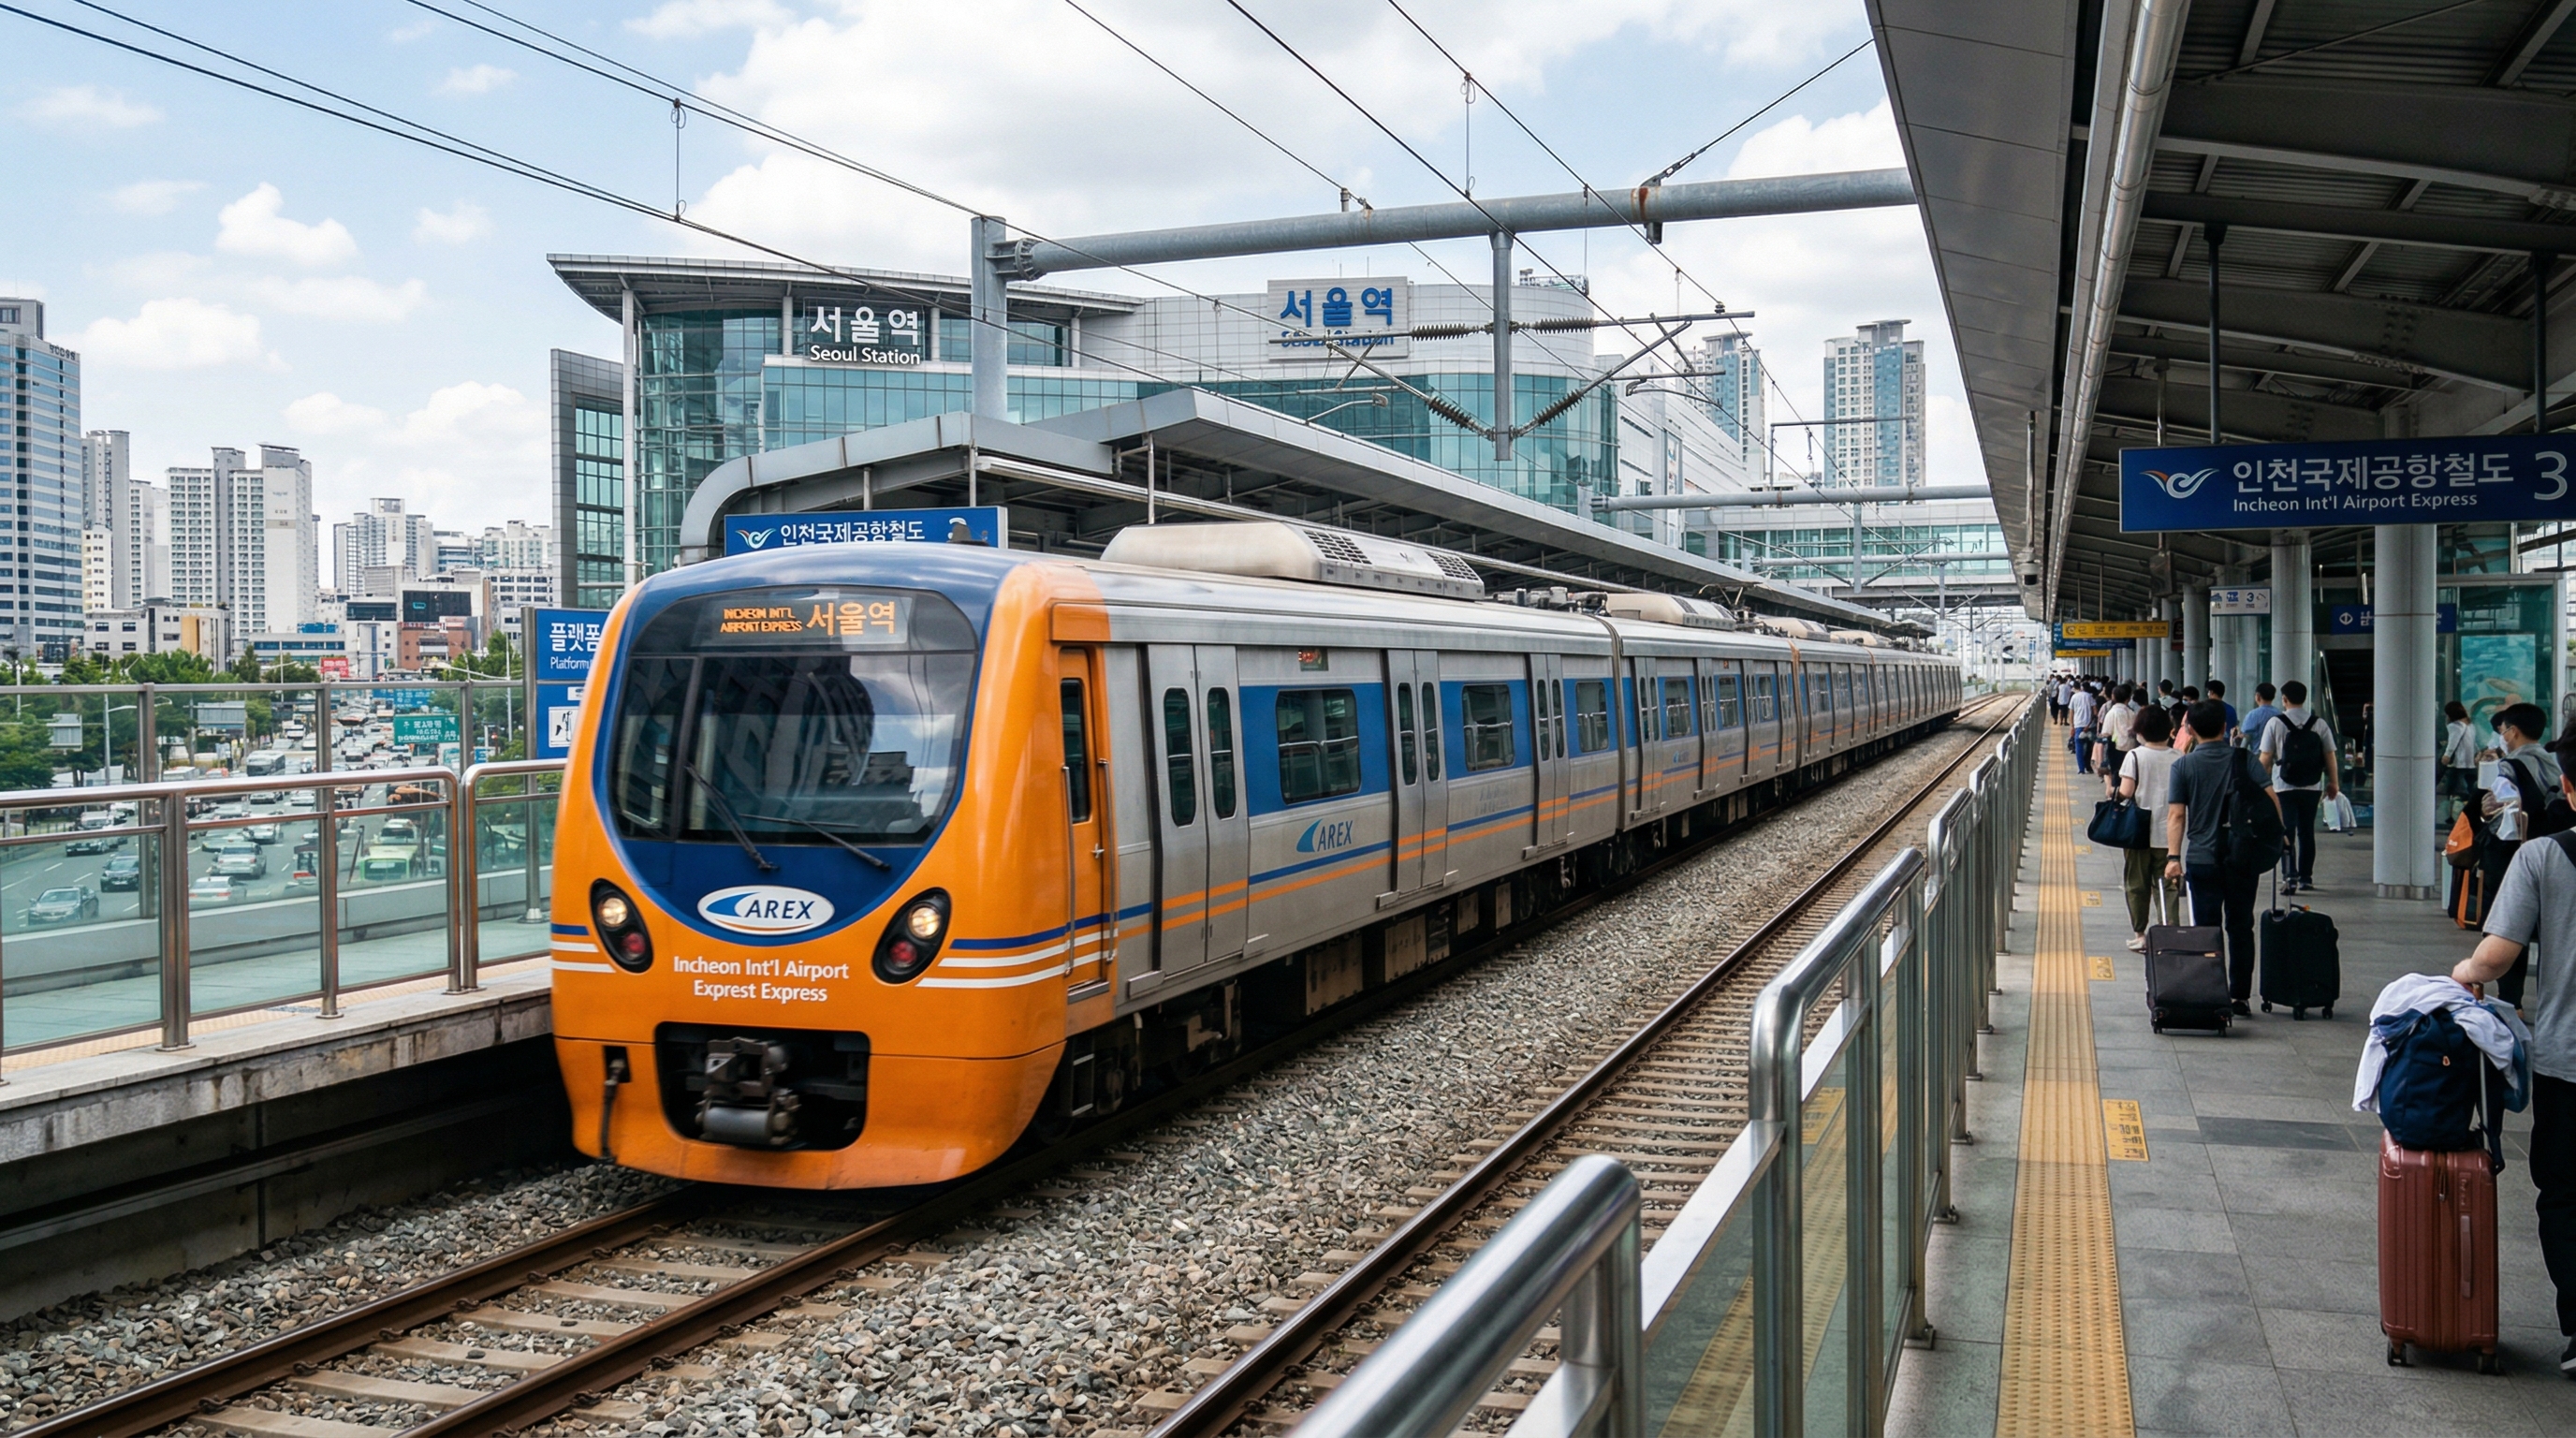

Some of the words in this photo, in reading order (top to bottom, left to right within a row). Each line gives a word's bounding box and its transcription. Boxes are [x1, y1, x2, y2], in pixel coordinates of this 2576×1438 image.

[1280, 287, 1392, 327] 서울역
[811, 306, 917, 345] 서울역
[810, 345, 857, 361] Seoul
[861, 347, 920, 364] Station
[2233, 453, 2514, 493] 인천국제공항철도
[2534, 450, 2568, 501] 3
[2233, 497, 2299, 512] Incheon
[2305, 495, 2337, 510] Int'l
[2343, 493, 2405, 511] Airport
[2411, 492, 2478, 510] Express
[781, 521, 925, 546] 인천국제공항철도
[806, 600, 895, 636] 서울역
[549, 623, 600, 652] 플랫폼
[1317, 820, 1353, 852] AREX
[744, 900, 815, 919] AREX
[674, 956, 740, 975] Incheon
[746, 959, 780, 976] Int'l
[784, 961, 849, 982] Airport
[694, 979, 756, 1001] Exprest
[761, 983, 827, 1005] Express
